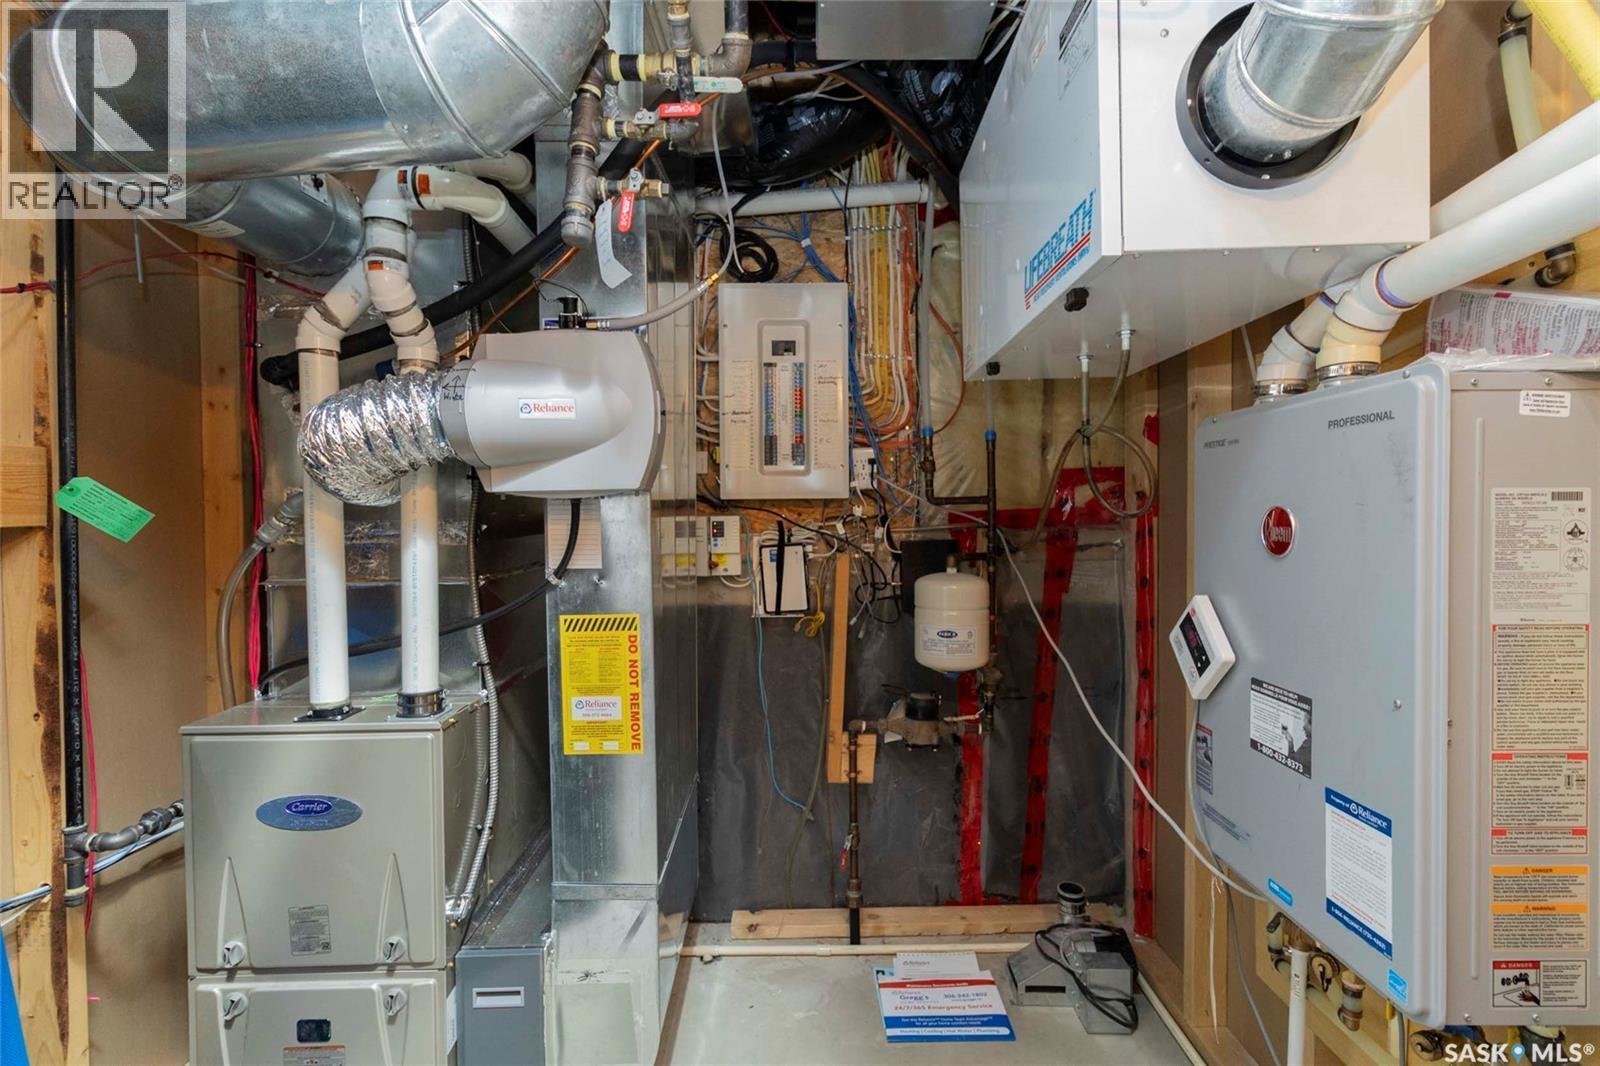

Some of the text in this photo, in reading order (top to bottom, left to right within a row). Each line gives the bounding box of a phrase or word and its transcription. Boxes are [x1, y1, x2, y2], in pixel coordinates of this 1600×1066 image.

[1024, 190, 1093, 294] LIFEBREATH
[533, 403, 575, 413] Reliance
[1327, 410, 1395, 430] PROFESSIONAL
[628, 634, 641, 751] DO NOT REMOVE
[585, 700, 617, 708] Reliance
[1256, 742, 1303, 772] 1-800-432-8373
[291, 802, 328, 811] Carrier
[1358, 805, 1388, 829] Reliance
